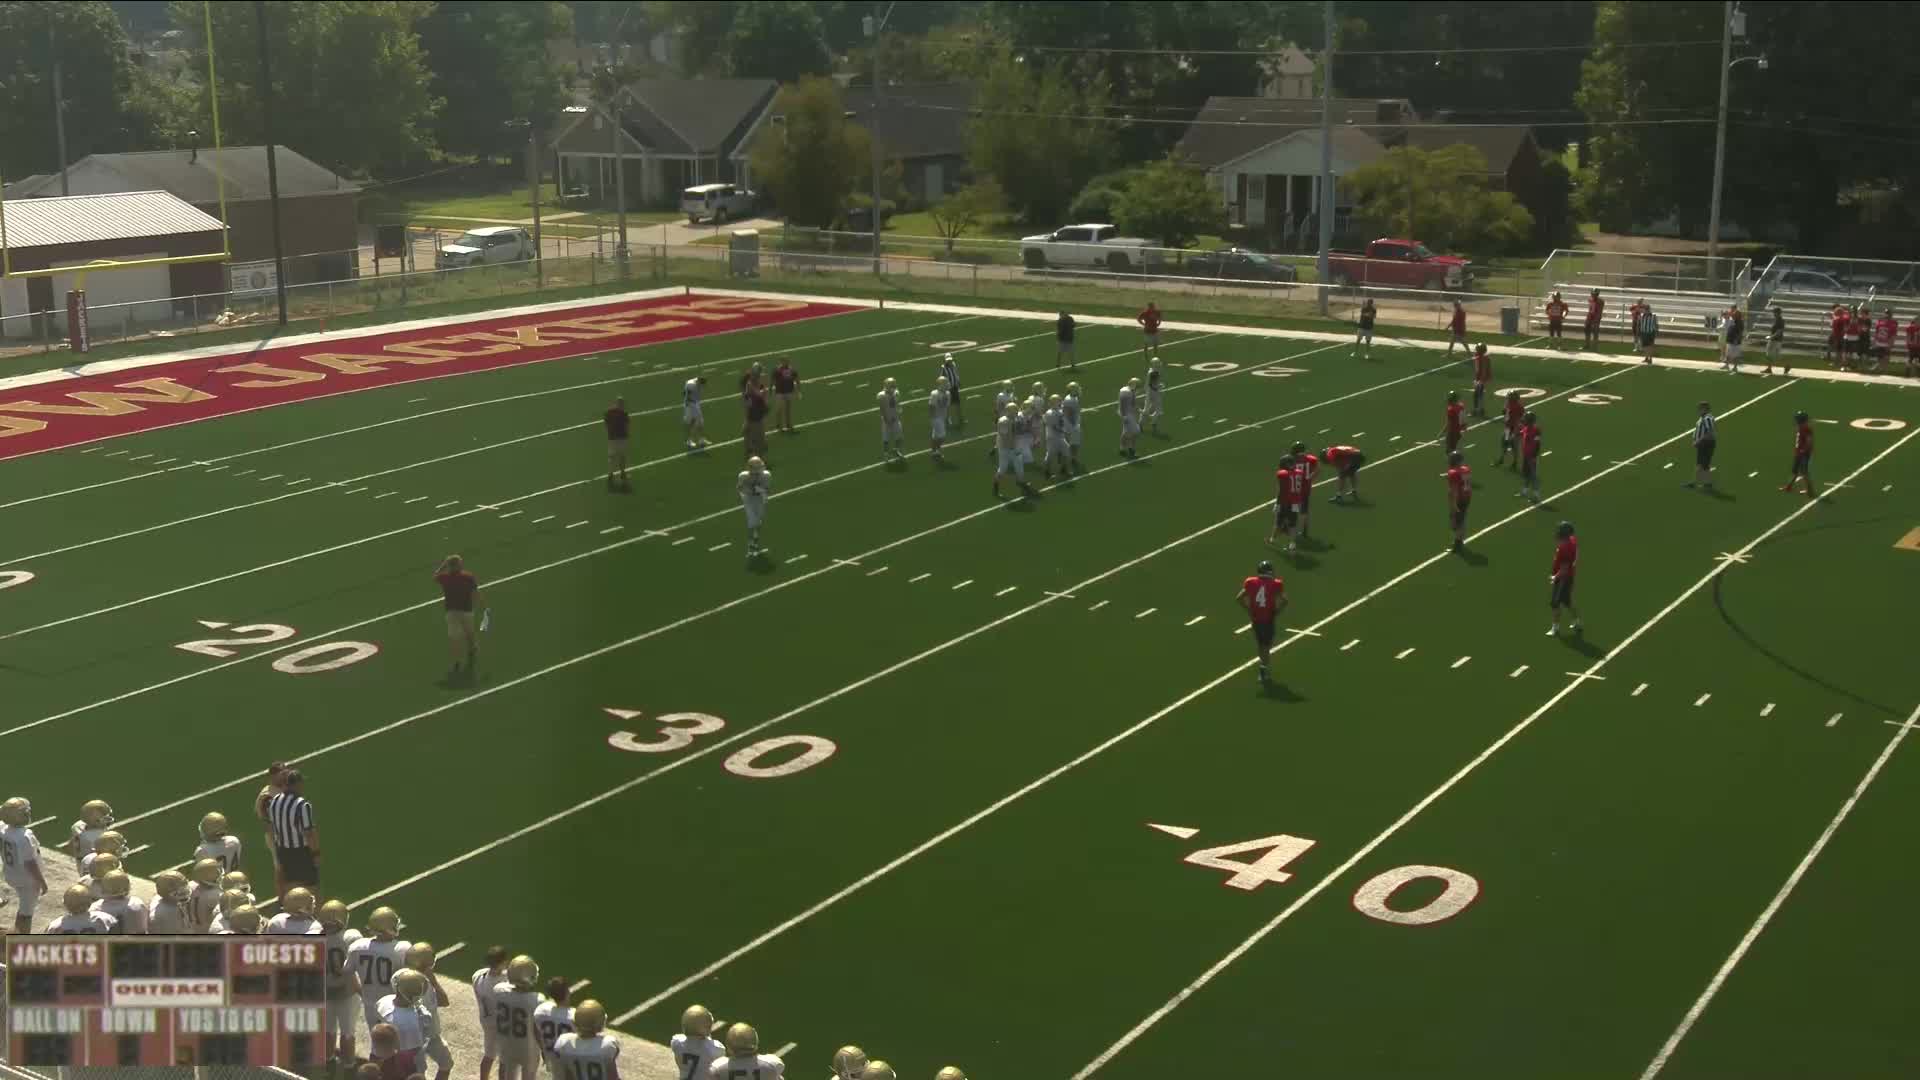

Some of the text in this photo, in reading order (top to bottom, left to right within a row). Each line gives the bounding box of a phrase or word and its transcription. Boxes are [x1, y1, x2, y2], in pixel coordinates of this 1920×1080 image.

[208, 299, 809, 388] JACKETS
[1256, 586, 1267, 608] 4
[608, 712, 837, 778] 30
[1183, 834, 1479, 925] 40
[359, 954, 393, 986] 70
[683, 1053, 700, 1080] 7
